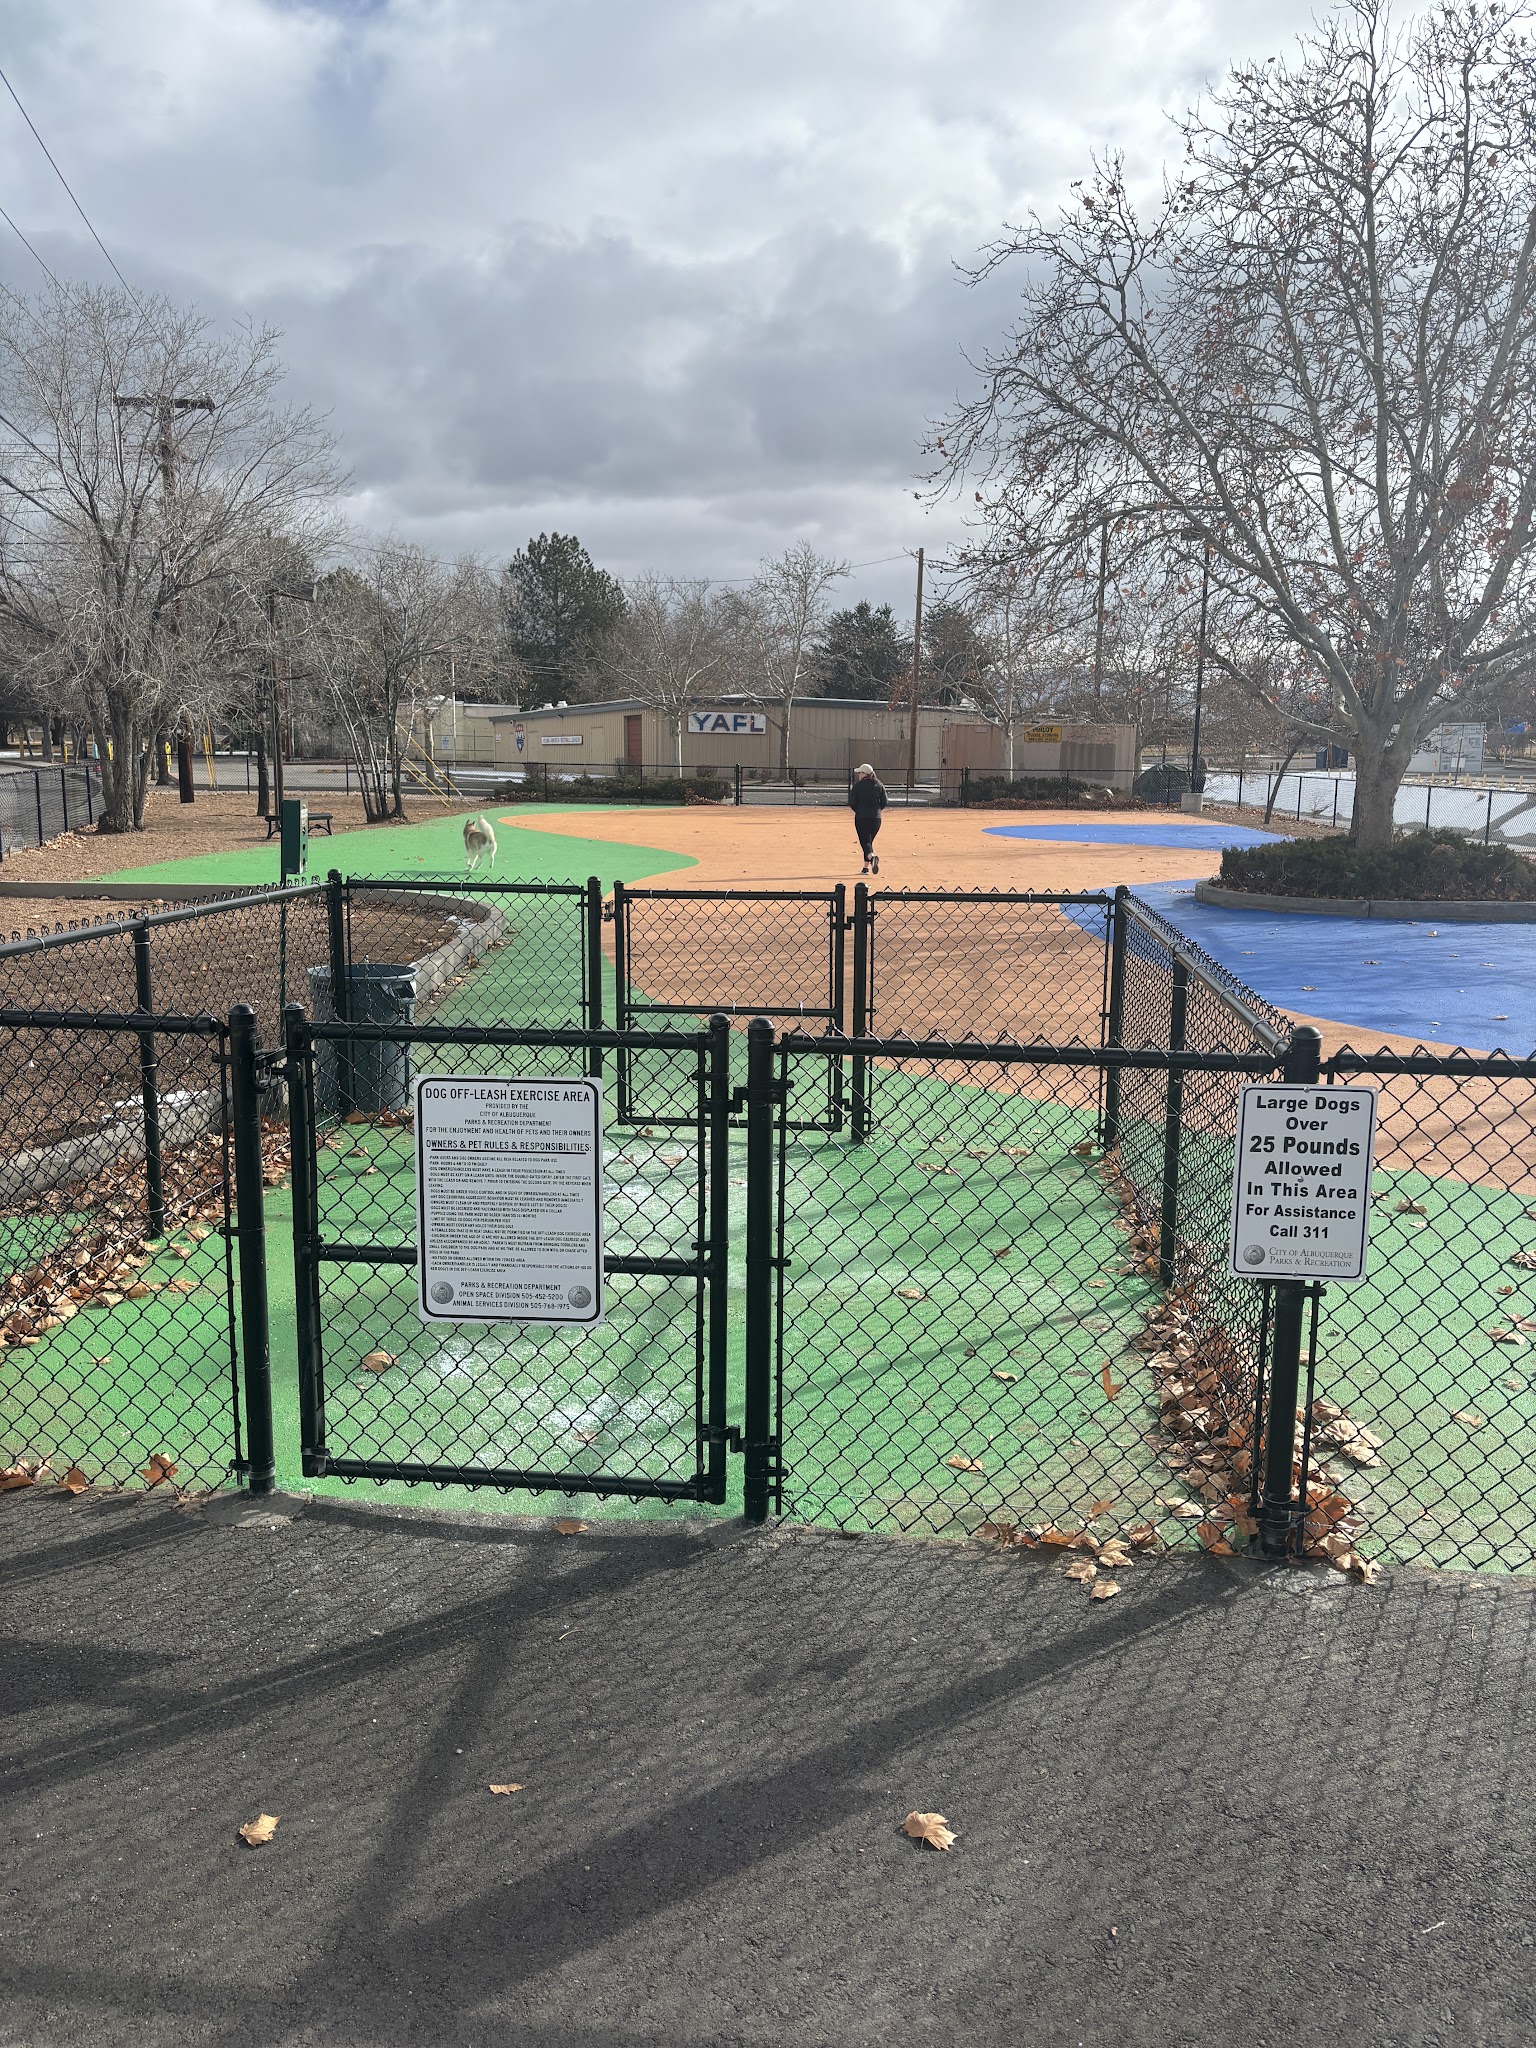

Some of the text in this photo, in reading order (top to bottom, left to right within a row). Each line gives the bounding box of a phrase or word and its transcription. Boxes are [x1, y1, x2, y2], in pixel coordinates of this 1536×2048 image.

[692, 713, 764, 732] YAFL
[425, 1088, 591, 1102] DOG OFF-LEASH EXERCISE AREA
[1256, 1095, 1361, 1113] Large Dogs
[1286, 1117, 1329, 1131] Over
[426, 1140, 592, 1152] OWNERS & PET RULES & RESPONSIBILITIES:
[1249, 1136, 1361, 1155] 25 Pounds
[1264, 1161, 1342, 1176] Allowed
[1247, 1182, 1358, 1199] In This Area
[1246, 1204, 1356, 1220] For Assistance
[1270, 1225, 1329, 1238] Call 311
[1295, 1257, 1301, 1266] &
[503, 1301, 529, 1309] DIVISION
